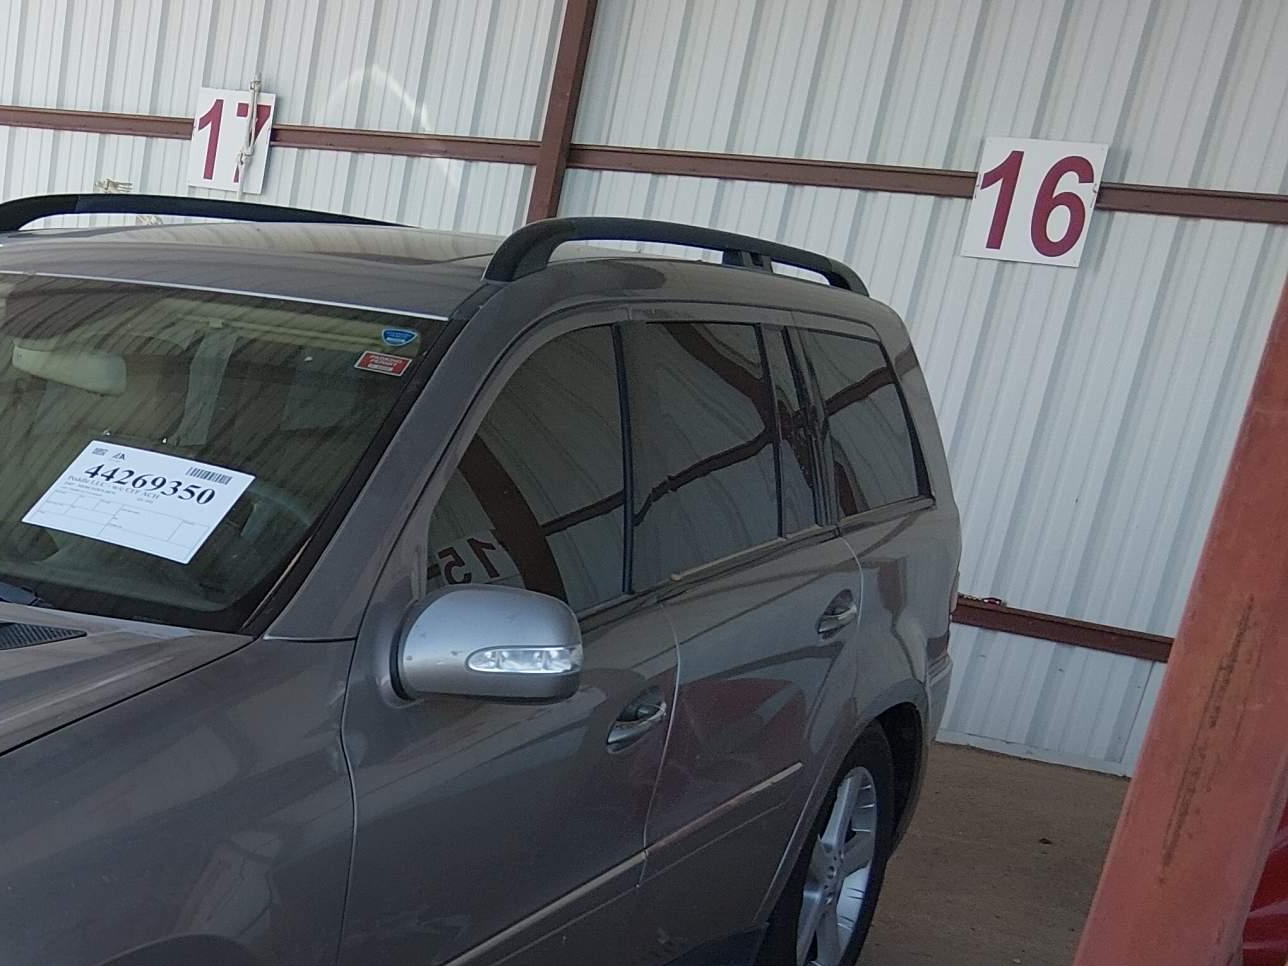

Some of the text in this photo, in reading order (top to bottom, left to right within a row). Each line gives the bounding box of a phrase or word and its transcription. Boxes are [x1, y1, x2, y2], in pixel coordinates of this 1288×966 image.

[198, 99, 272, 183] 17
[980, 150, 1094, 258] 16
[84, 463, 216, 505] 44269350
